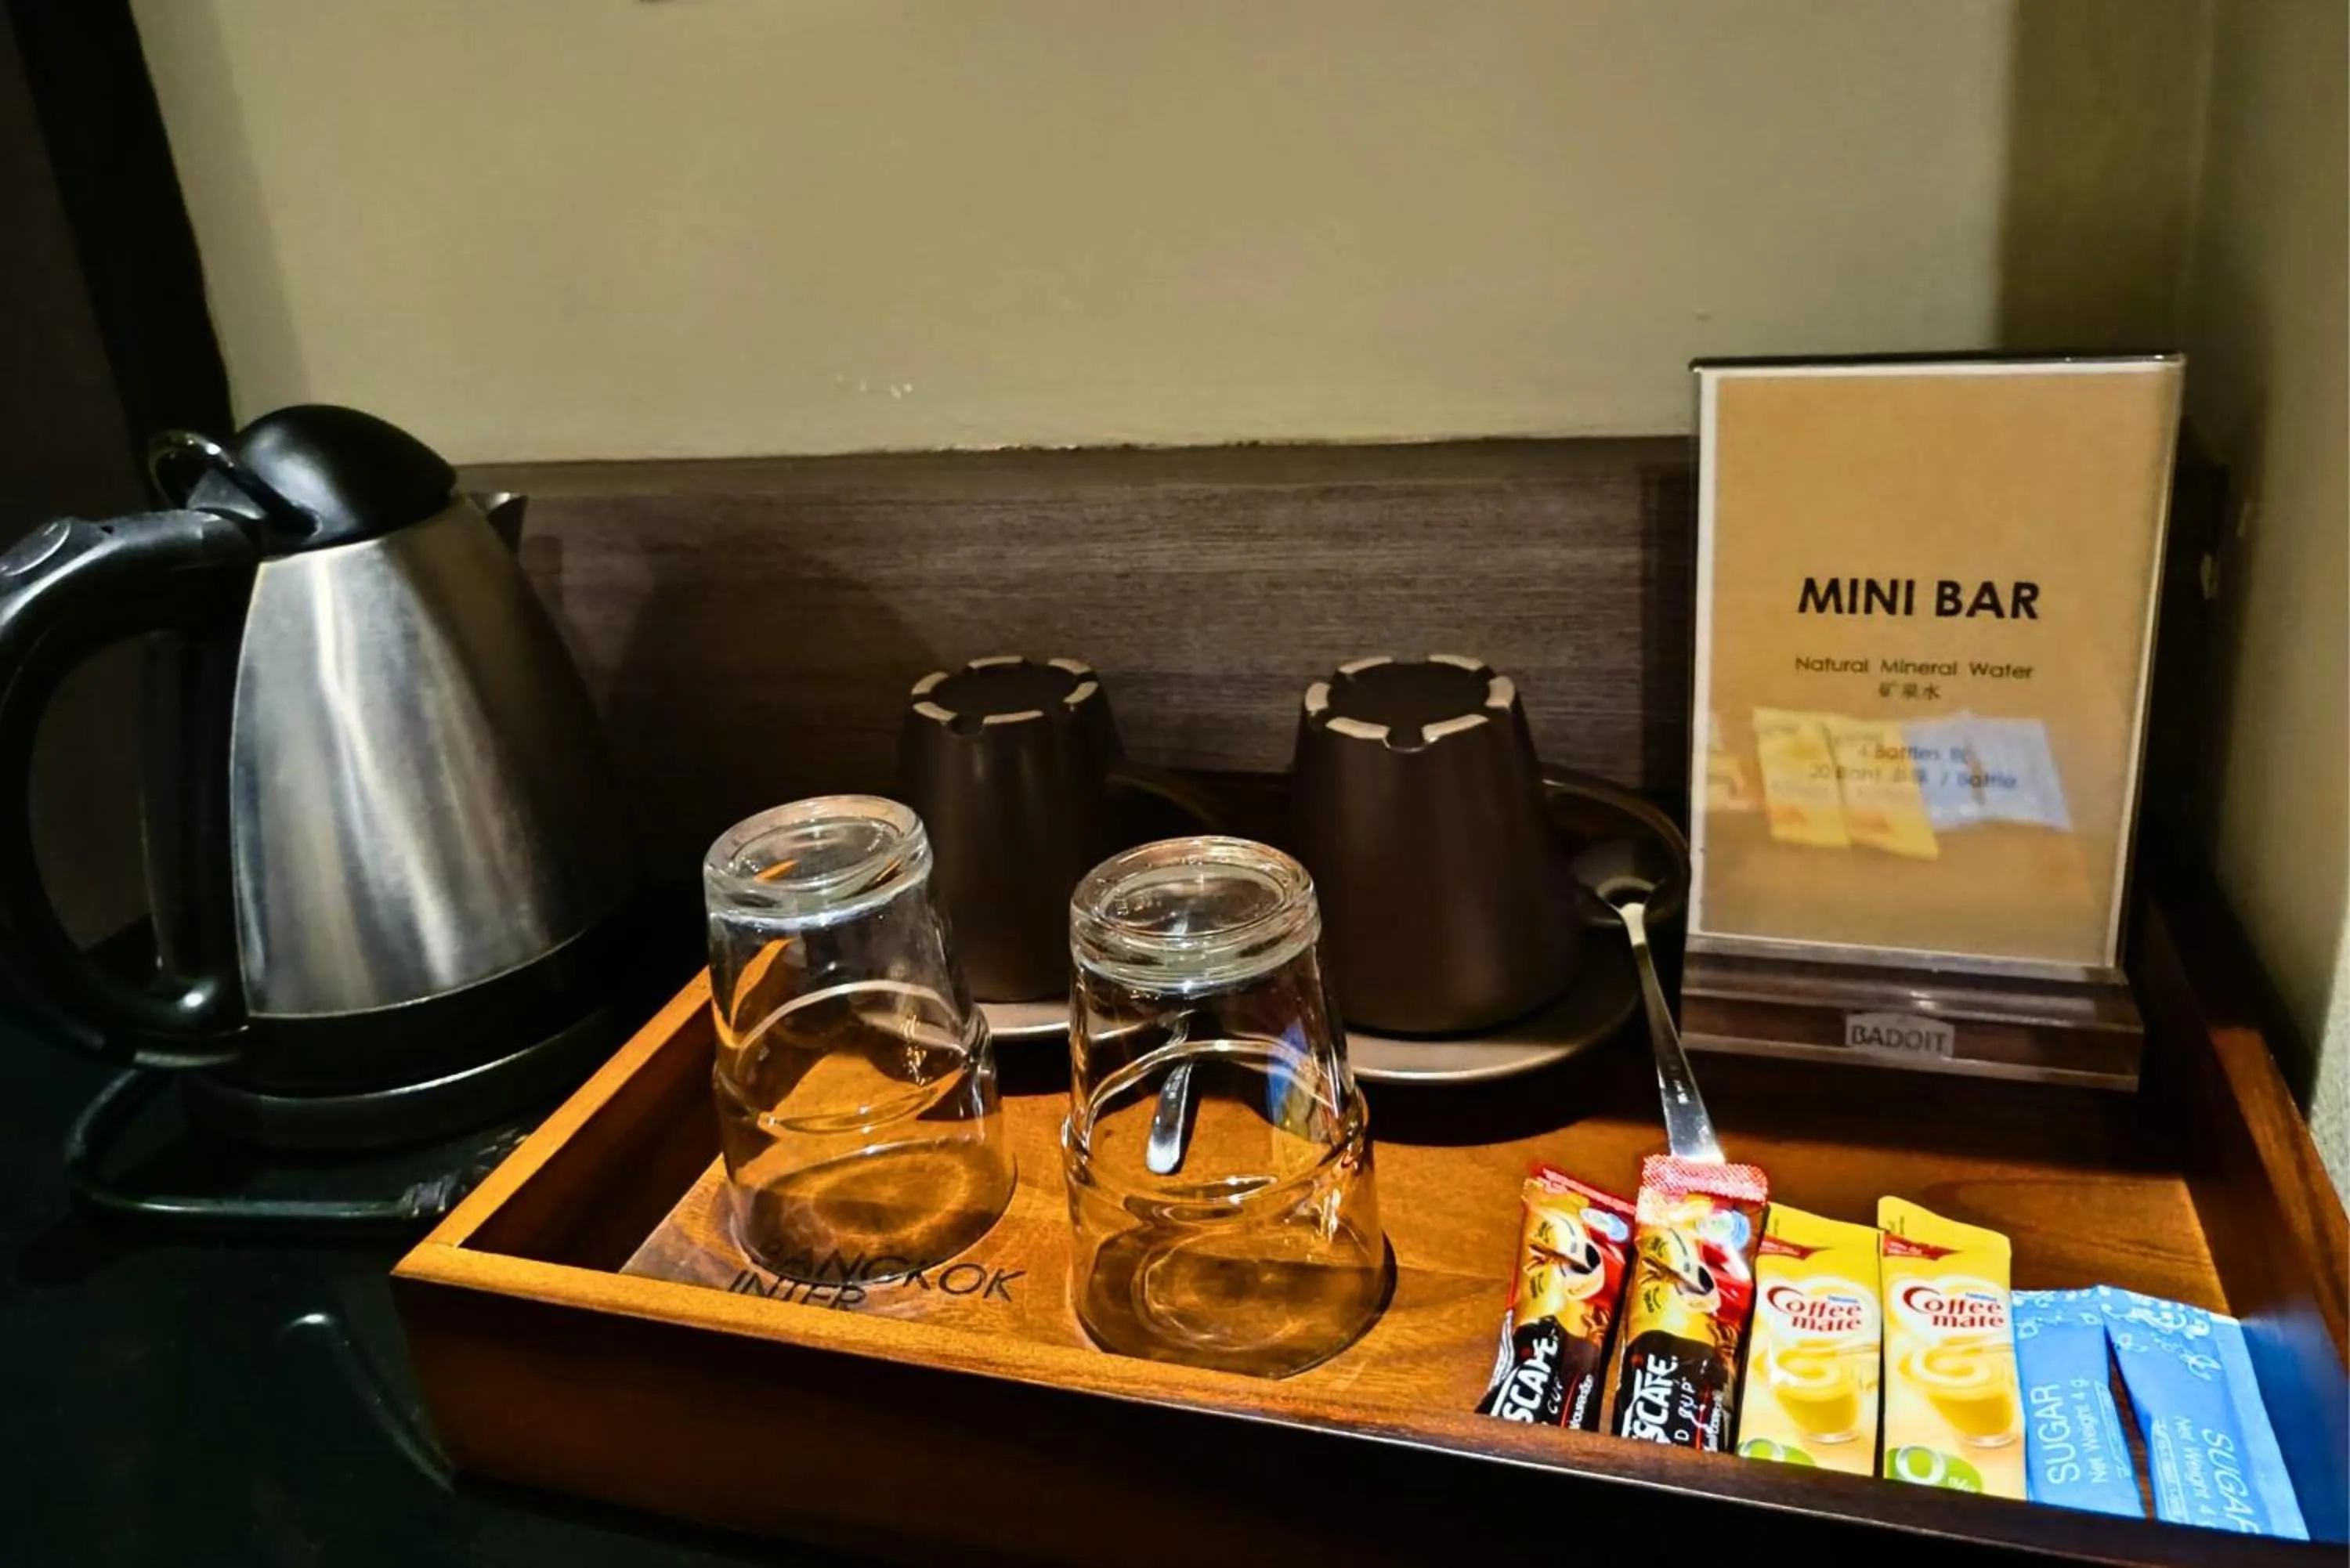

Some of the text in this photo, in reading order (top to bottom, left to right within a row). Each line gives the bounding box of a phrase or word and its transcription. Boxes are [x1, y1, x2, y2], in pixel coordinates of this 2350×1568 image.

[1798, 577, 2041, 620] MINI BAR
[1795, 656, 2034, 679] Natural Mineral Water
[1875, 744, 1941, 761] Bottles
[1851, 1025, 1947, 1052] BADOIT
[1766, 1284, 1862, 1322] Coffee
[1902, 1285, 2002, 1320] Coffee
[1791, 1313, 1862, 1332] mate
[1932, 1313, 2005, 1329] mate
[2030, 1384, 2081, 1485] SUGAR
[2073, 1404, 2102, 1453] Weight
[2088, 1457, 2109, 1483] Net
[2182, 1447, 2211, 1499] Weight
